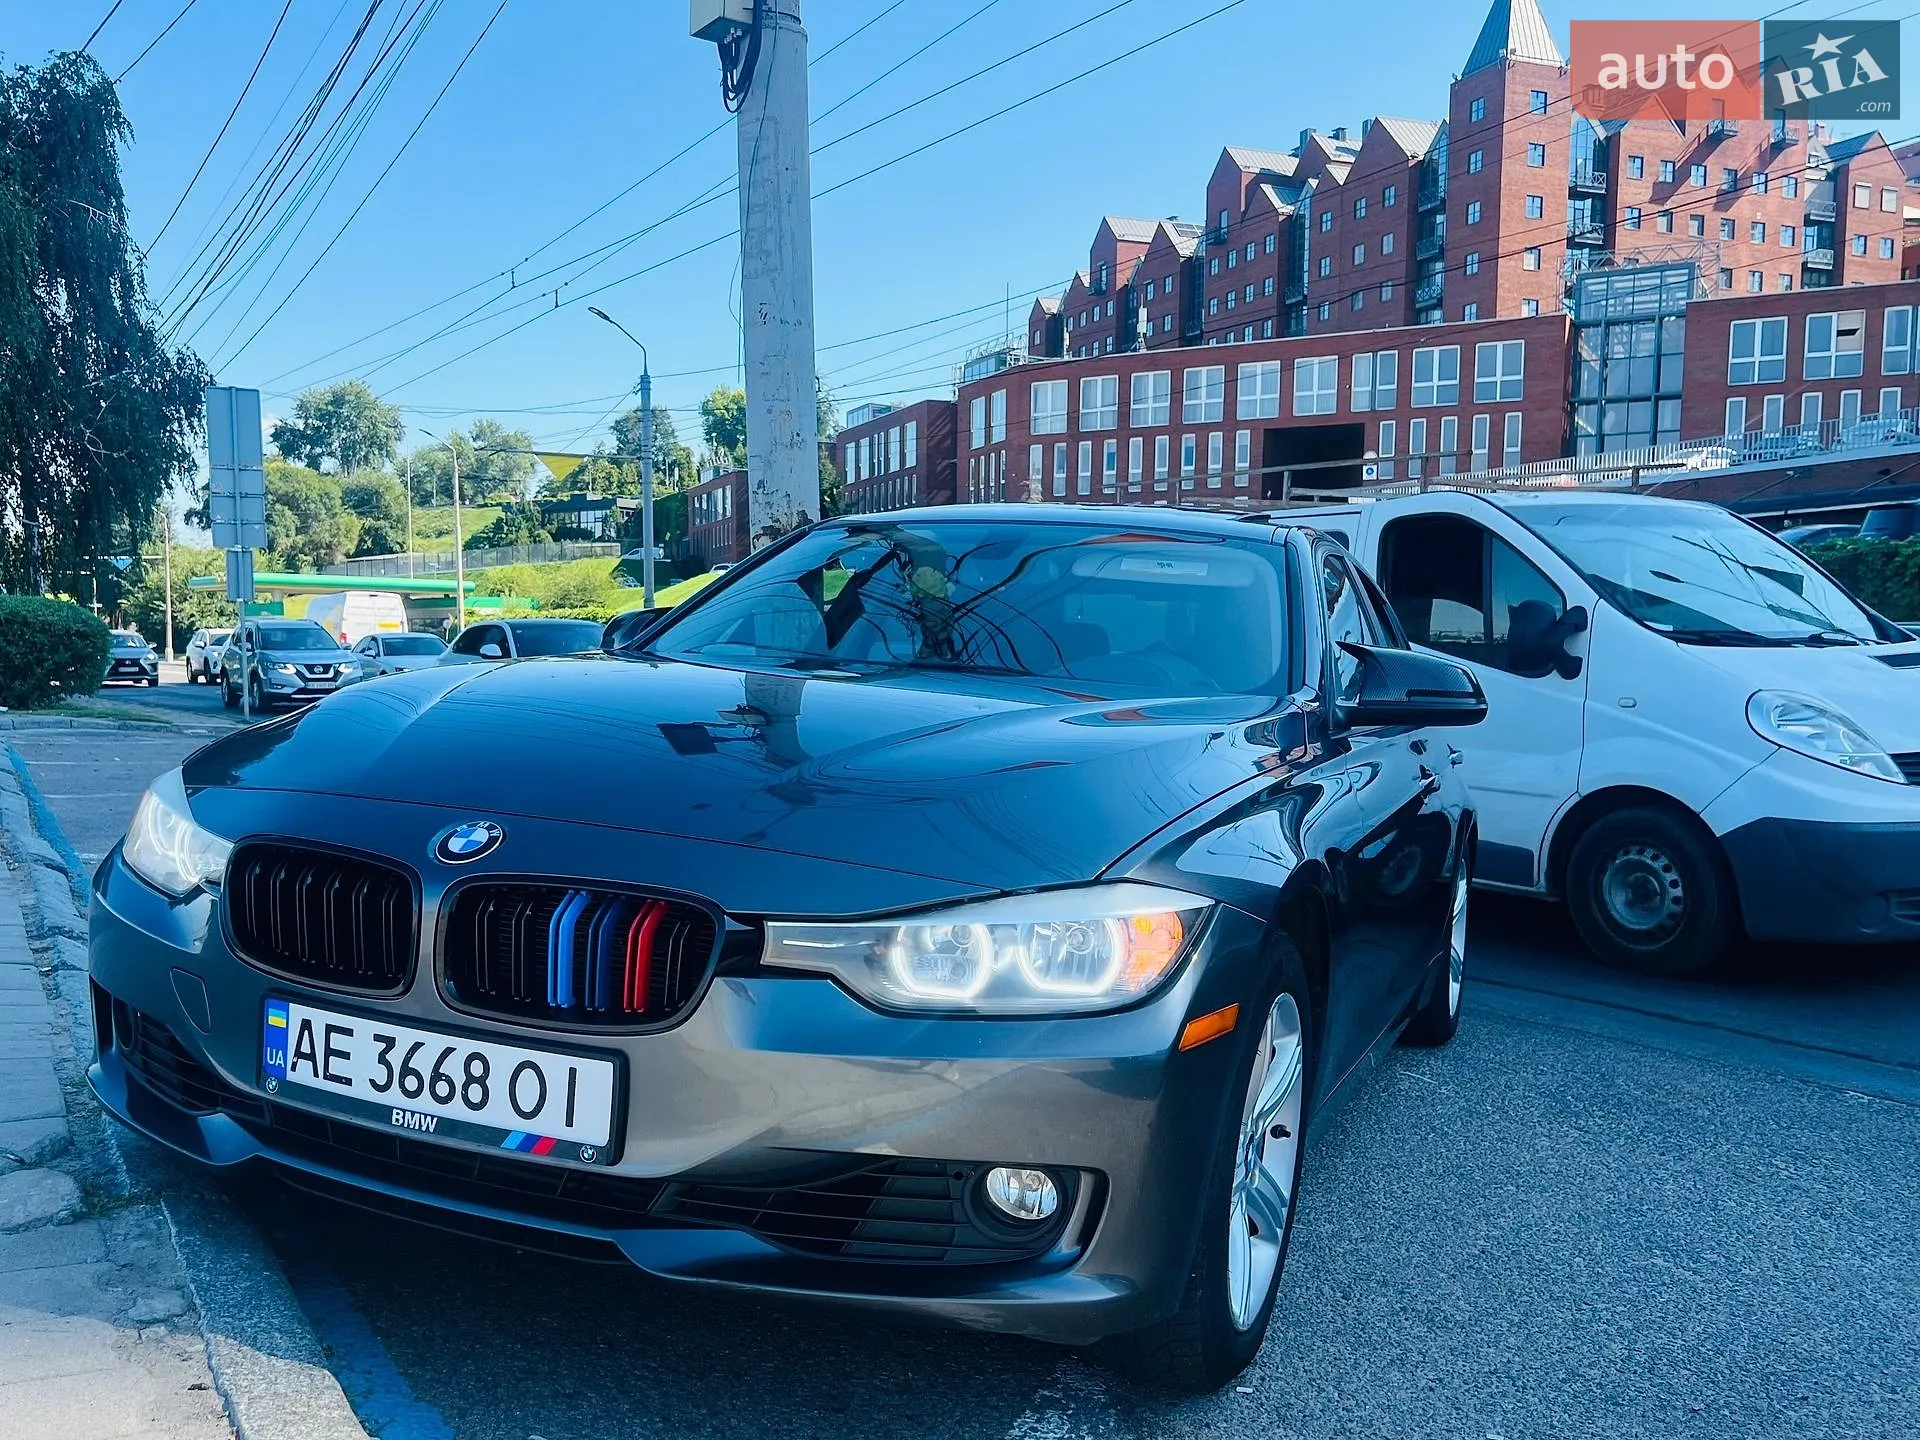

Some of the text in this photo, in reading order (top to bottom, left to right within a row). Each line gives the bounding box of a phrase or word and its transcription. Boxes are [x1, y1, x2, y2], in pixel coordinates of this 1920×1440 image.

[266, 1048, 285, 1068] UA
[290, 1017, 578, 1128] AE 3668 OI
[391, 1107, 438, 1133] BMW
